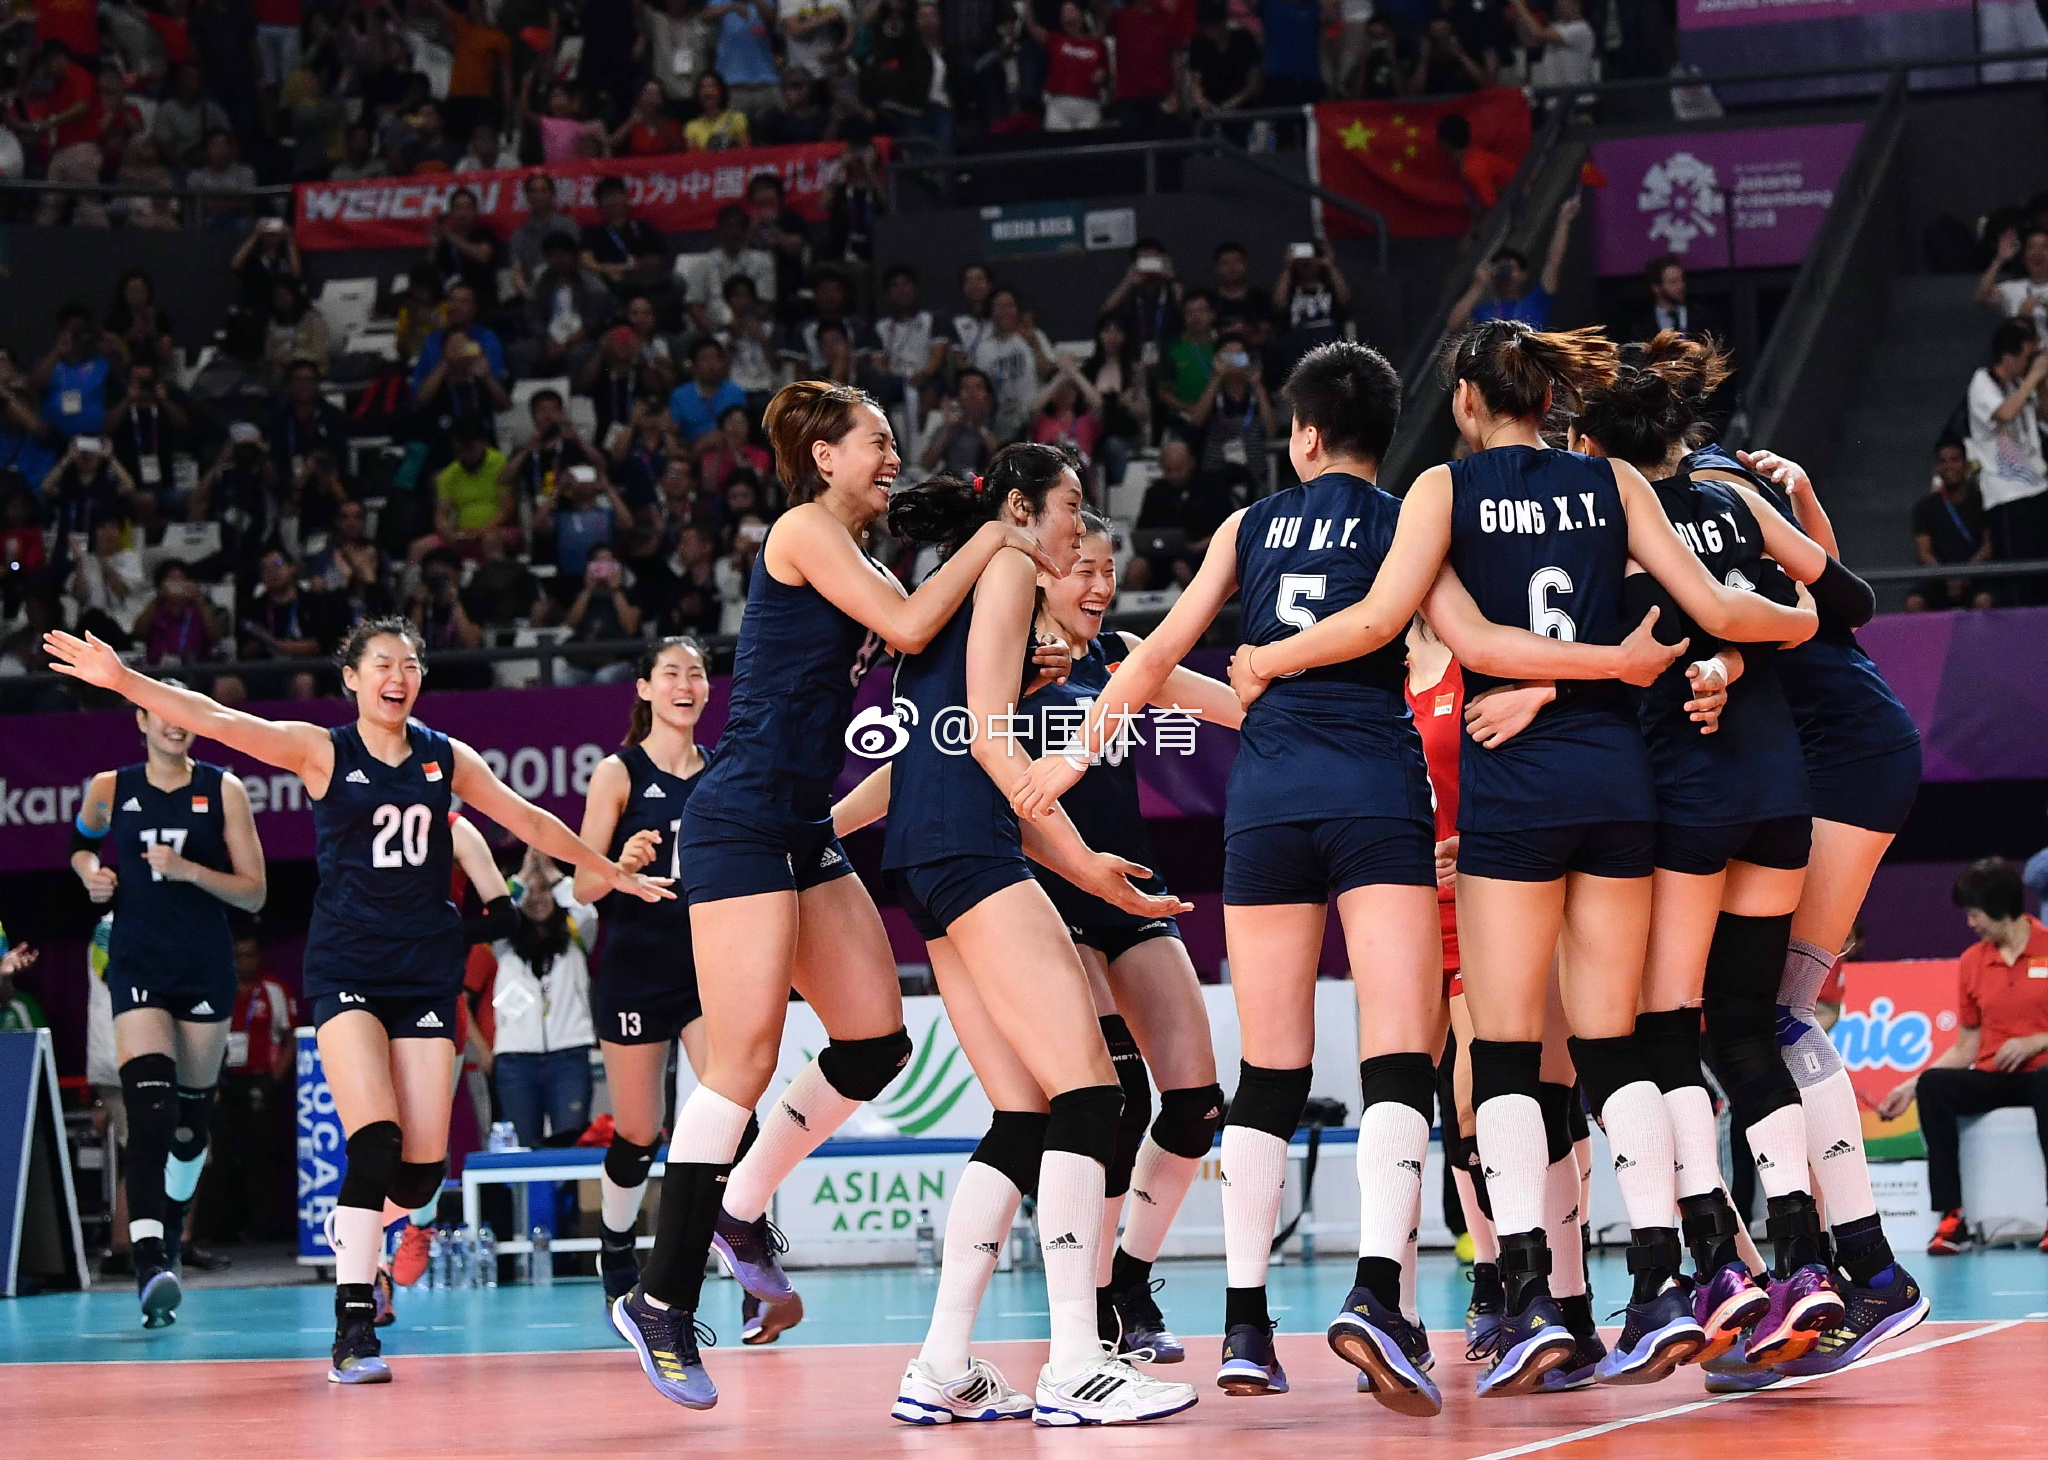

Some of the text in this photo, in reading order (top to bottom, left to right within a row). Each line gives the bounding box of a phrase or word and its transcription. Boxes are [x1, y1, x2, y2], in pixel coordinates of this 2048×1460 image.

[1264, 516, 1303, 549] HU
[1480, 492, 1606, 535] GONG X.Y.
[1528, 565, 1577, 642] 6
[139, 828, 188, 881] 17
[372, 803, 432, 869] 20
[618, 1011, 642, 1037] 13
[312, 1048, 340, 1246] OCARI
[812, 1169, 945, 1205] ASIAN
